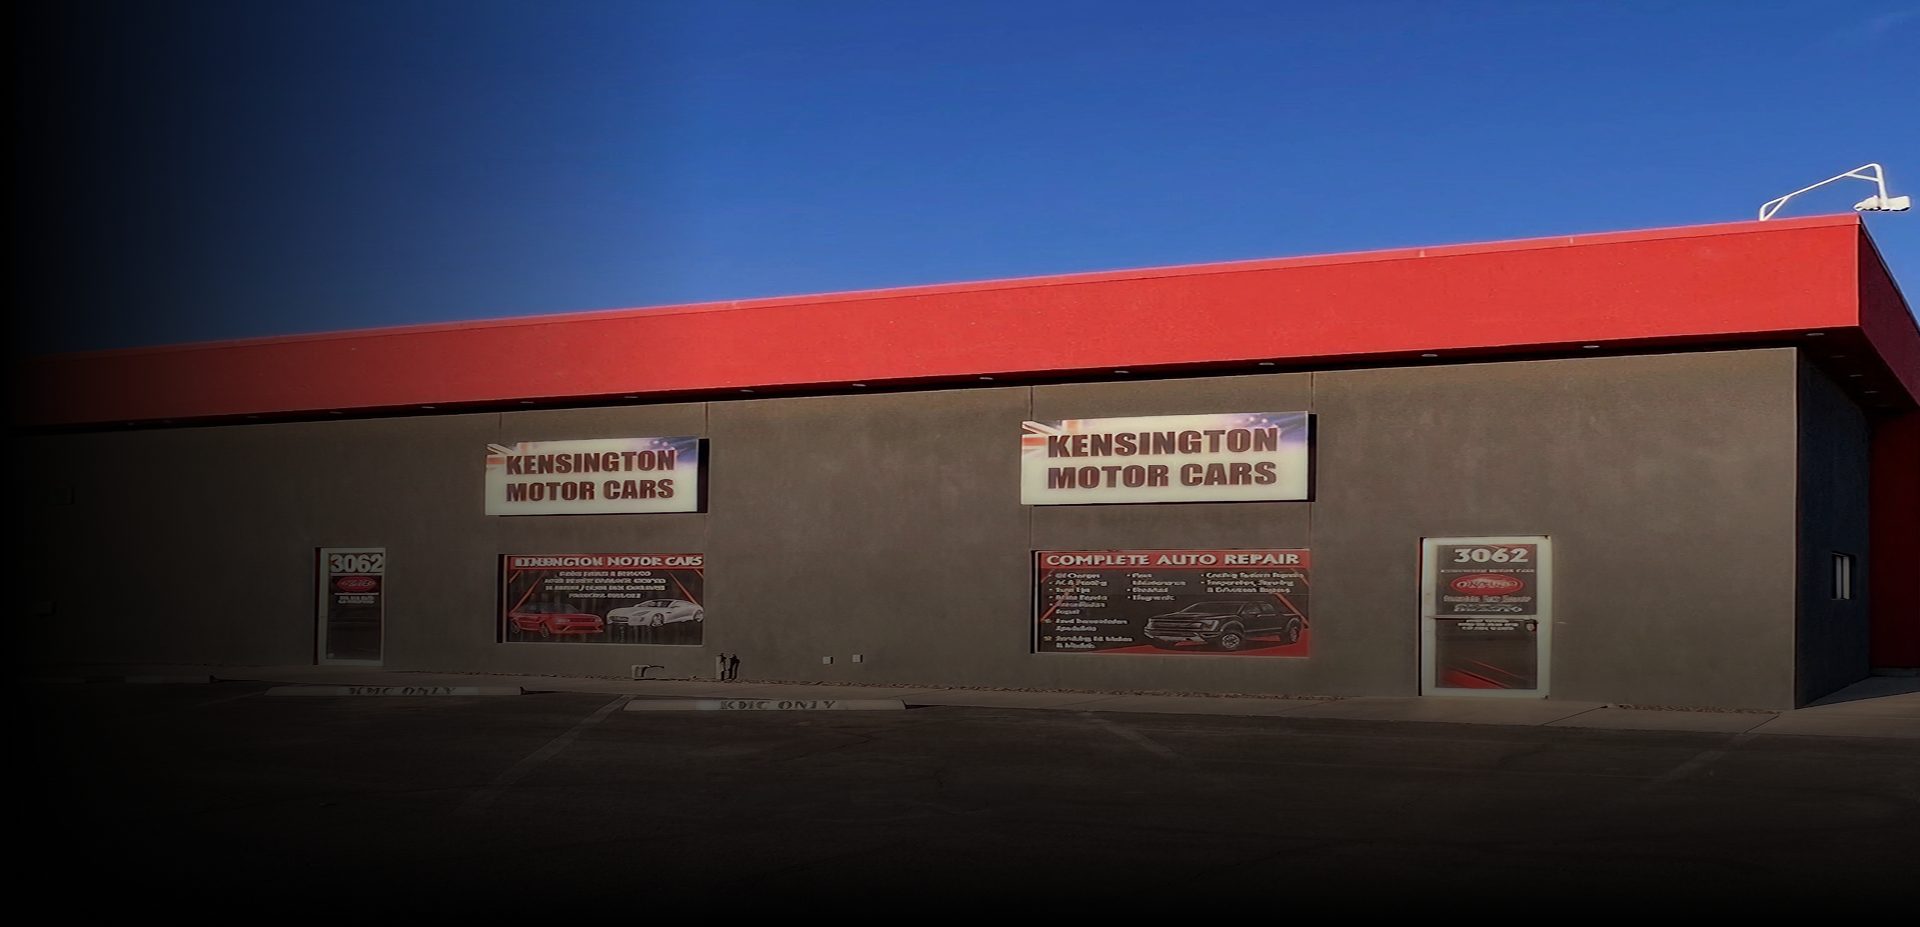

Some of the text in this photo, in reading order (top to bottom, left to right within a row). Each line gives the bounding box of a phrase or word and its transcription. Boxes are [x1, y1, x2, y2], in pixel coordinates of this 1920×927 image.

[1047, 428, 1279, 458] KENSINGTON
[506, 449, 675, 475] KENSINGTON
[1047, 461, 1278, 490] MOTOR CARS
[506, 478, 674, 502] MOTOR CARS
[330, 554, 383, 573] 3062
[1046, 553, 1300, 566] COMPLETE AUTO REPAIR
[1454, 548, 1529, 563] 3062
[401, 687, 456, 696] ONLY
[777, 700, 836, 711] ONLY
